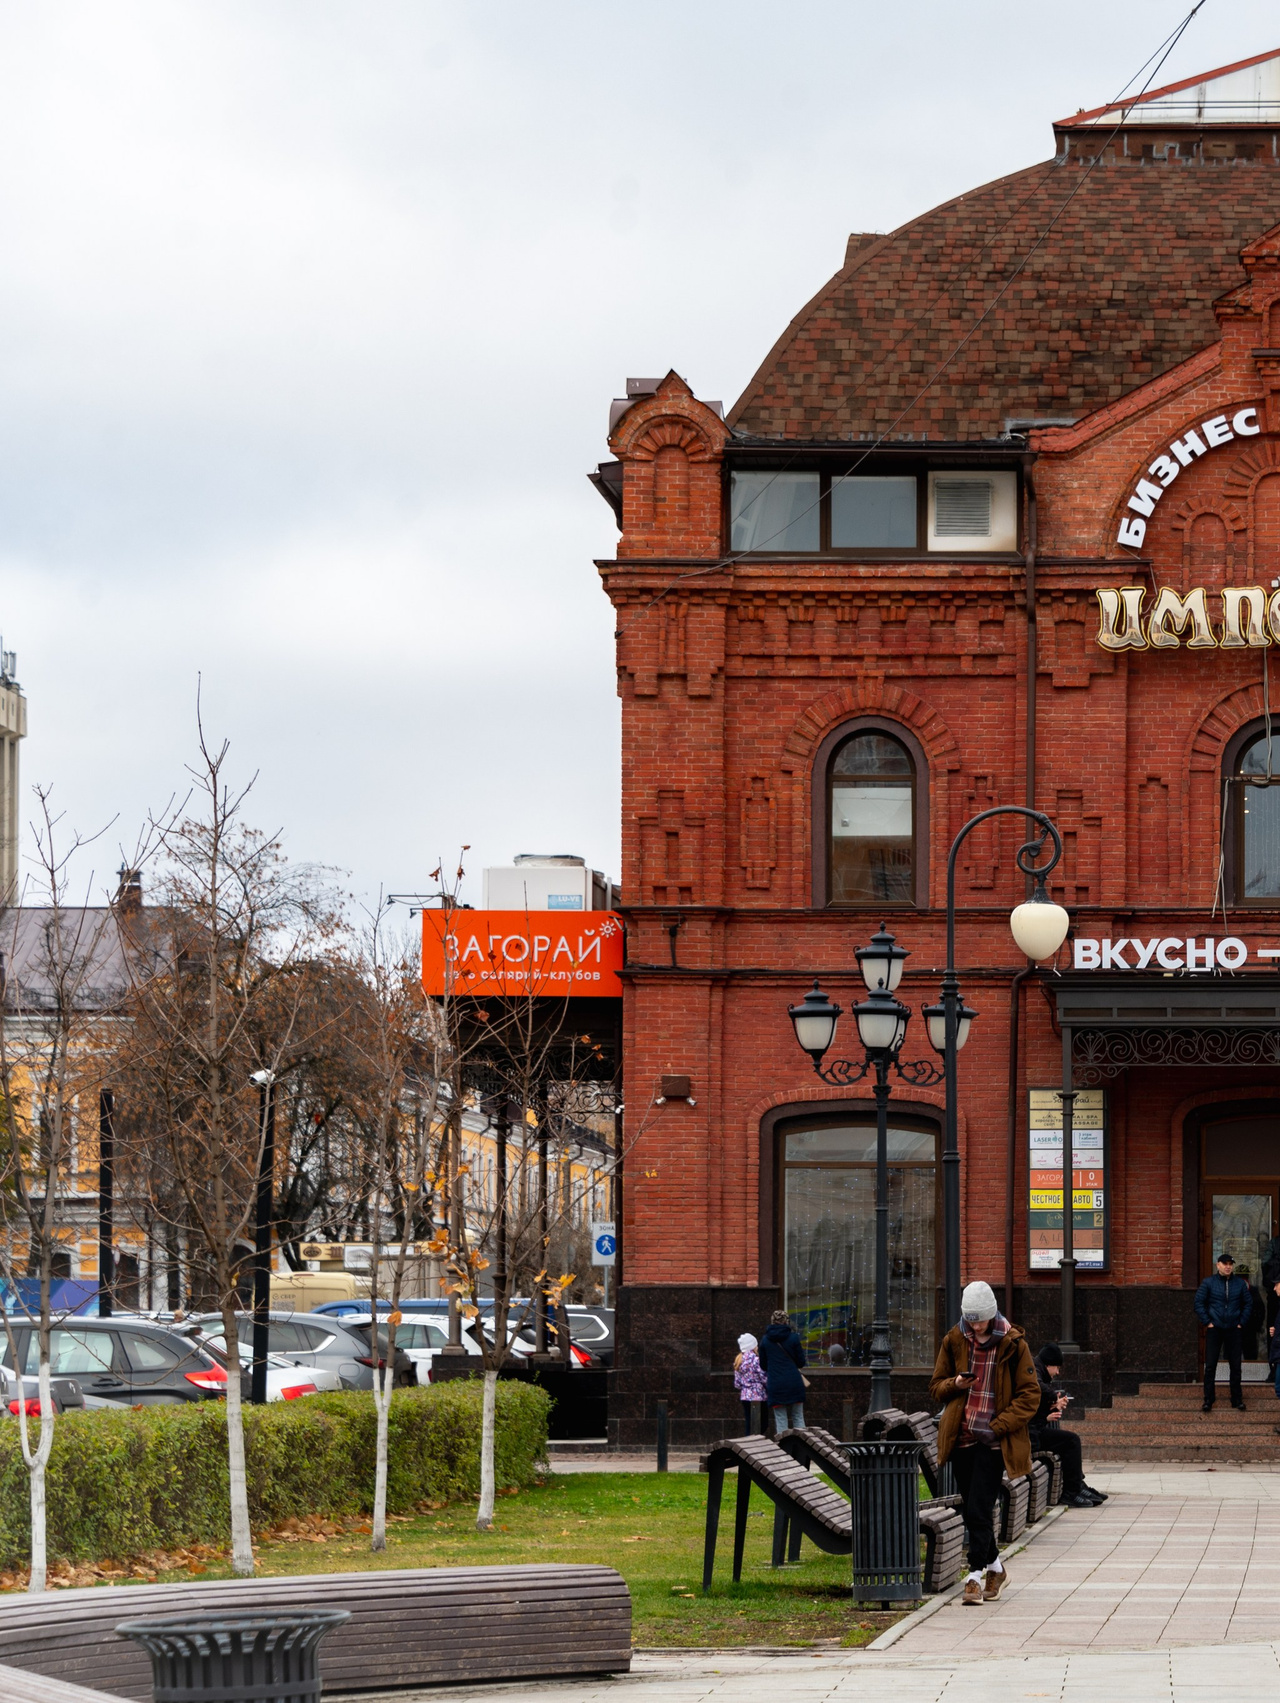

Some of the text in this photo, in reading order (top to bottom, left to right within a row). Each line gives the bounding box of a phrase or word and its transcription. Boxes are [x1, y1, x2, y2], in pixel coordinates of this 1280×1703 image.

[1117, 407, 1260, 549] БИЗНЕС
[446, 929, 601, 964] ЗАГОРАЙ
[1074, 937, 1248, 969] ВКУСНО
[1037, 1174, 1063, 1182] ЗАГОРА
[1031, 1194, 1102, 1208] ЧЕСТНОЕ АВТО 5
[1095, 1214, 1102, 1223] 2
